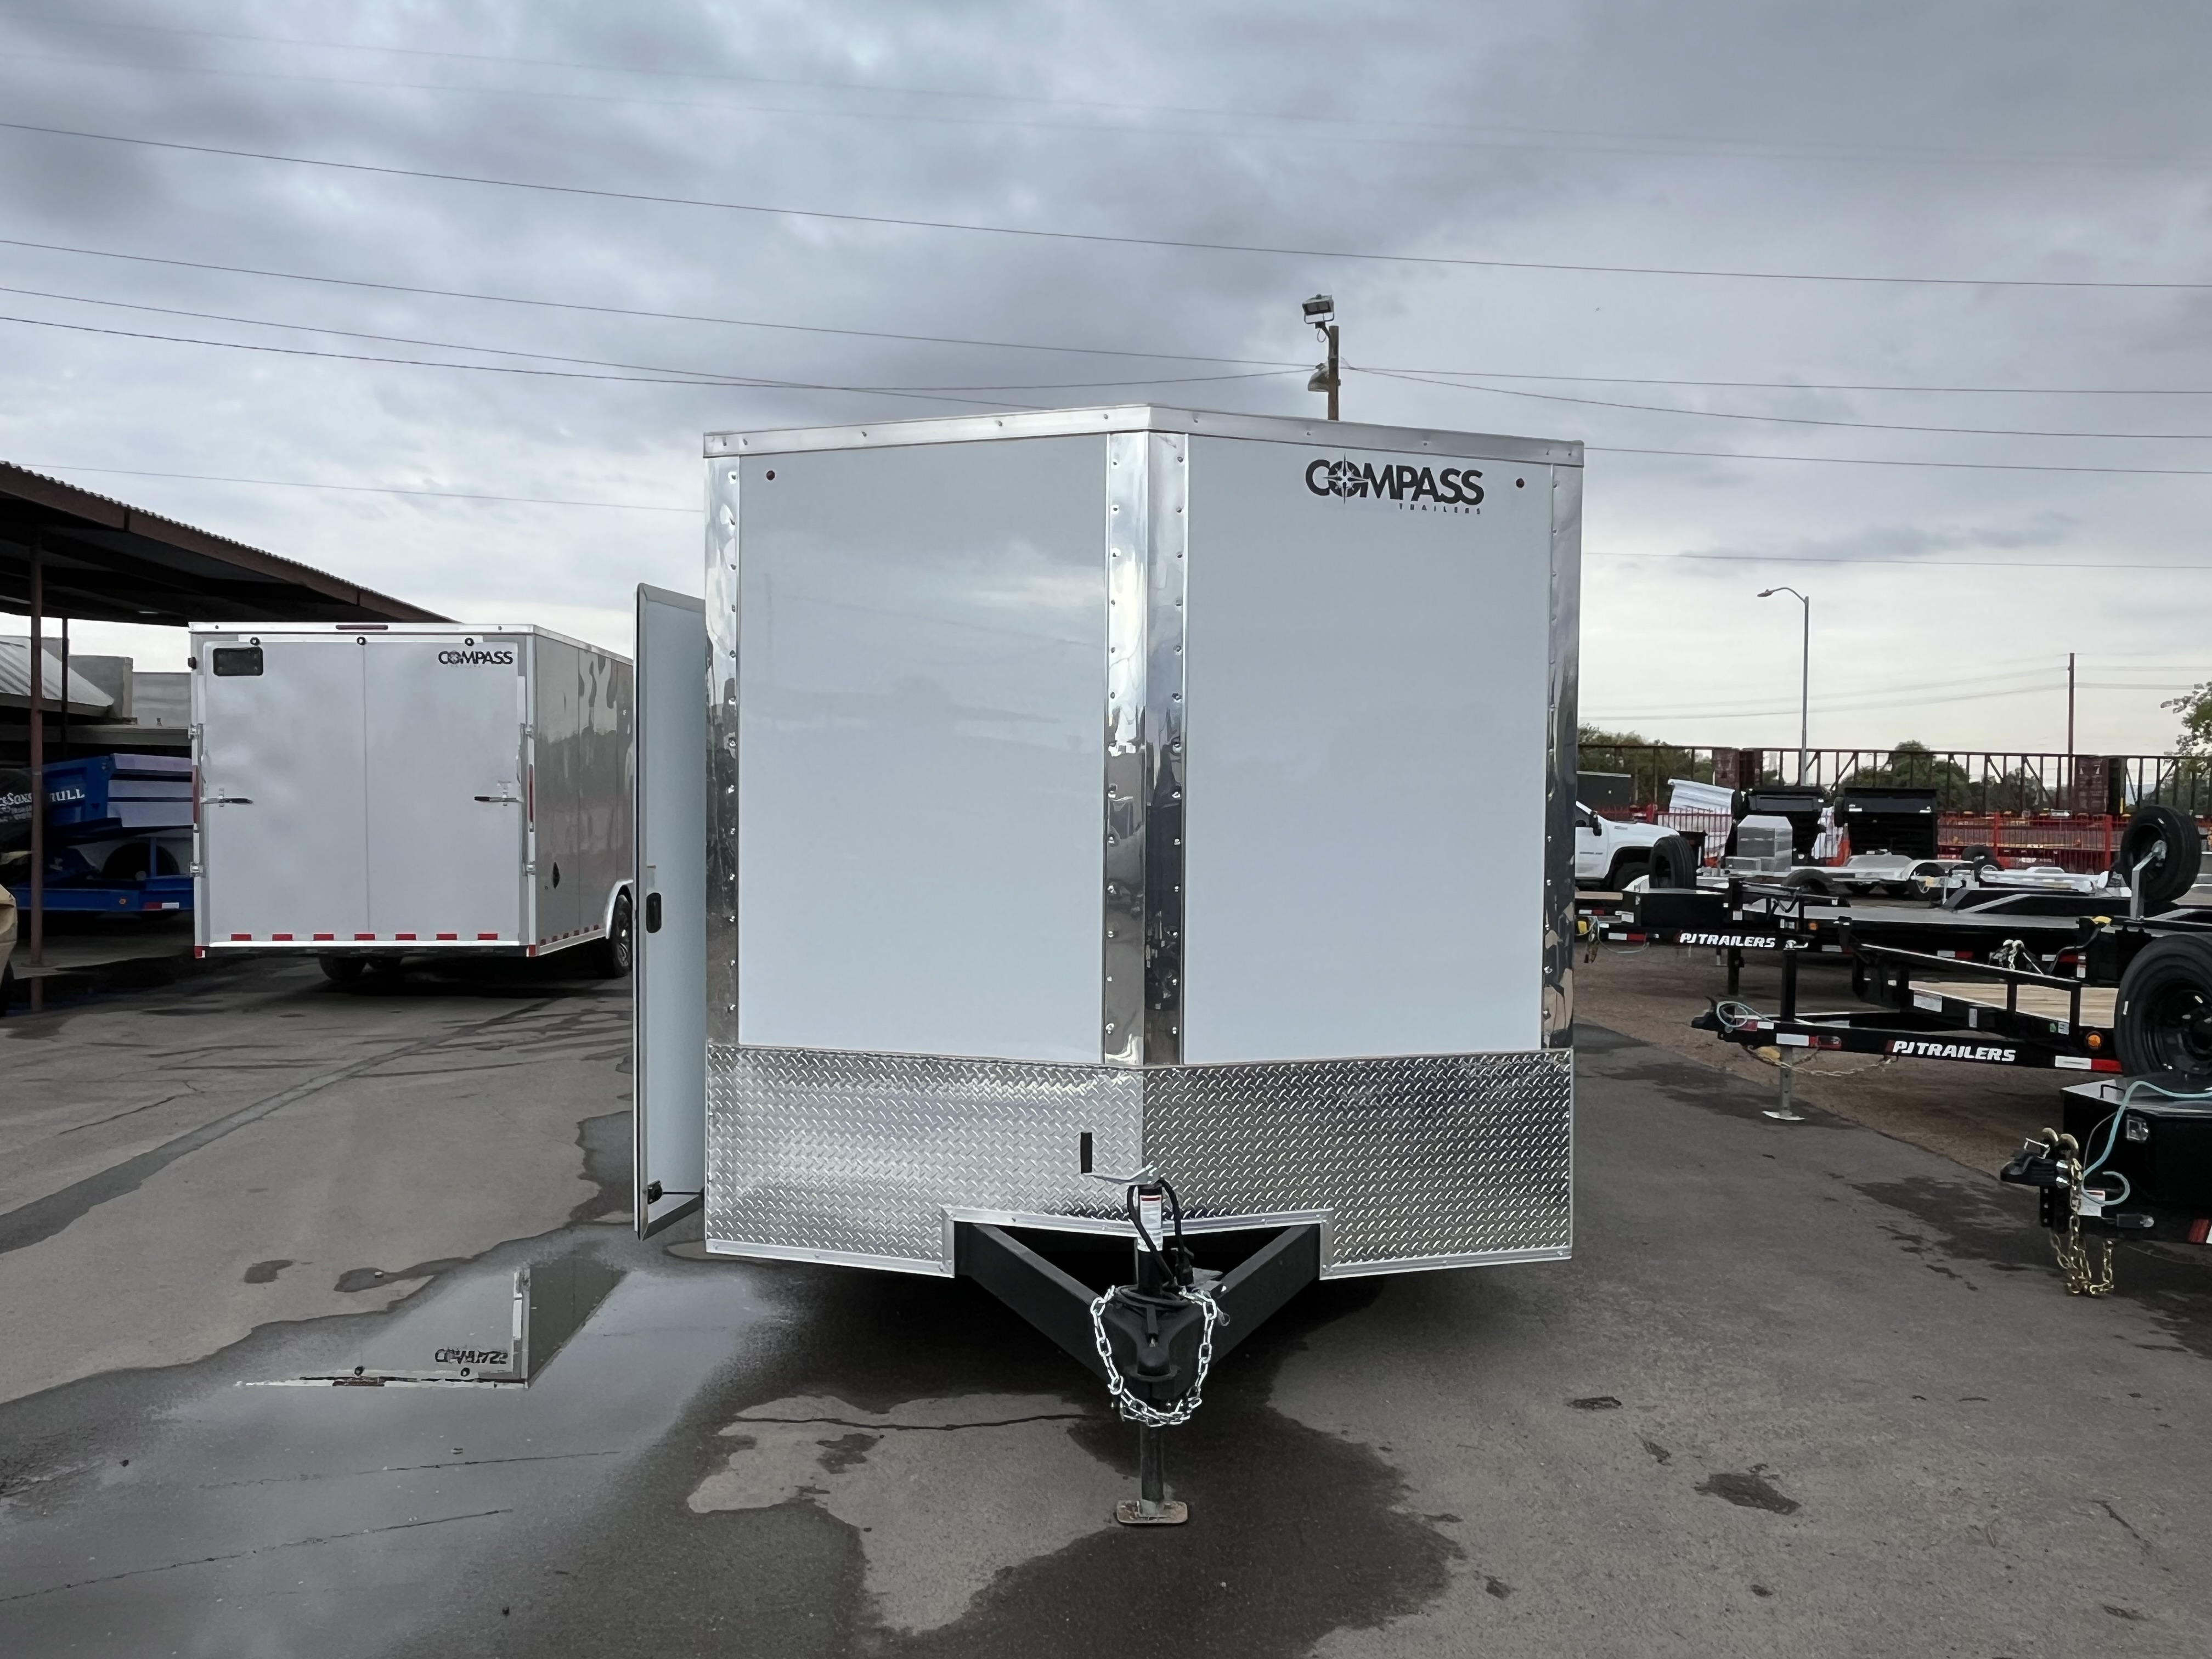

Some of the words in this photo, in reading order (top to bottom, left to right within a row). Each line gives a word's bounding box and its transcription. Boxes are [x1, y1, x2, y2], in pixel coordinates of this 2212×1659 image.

[1305, 459, 1484, 505] COMPASS
[438, 651, 513, 664] COMPASS
[1679, 933, 1697, 943] PJ
[1699, 934, 1776, 947] TRAILERS
[1892, 1041, 1915, 1054] PJ
[1916, 1042, 2016, 1062] TRAILERS
